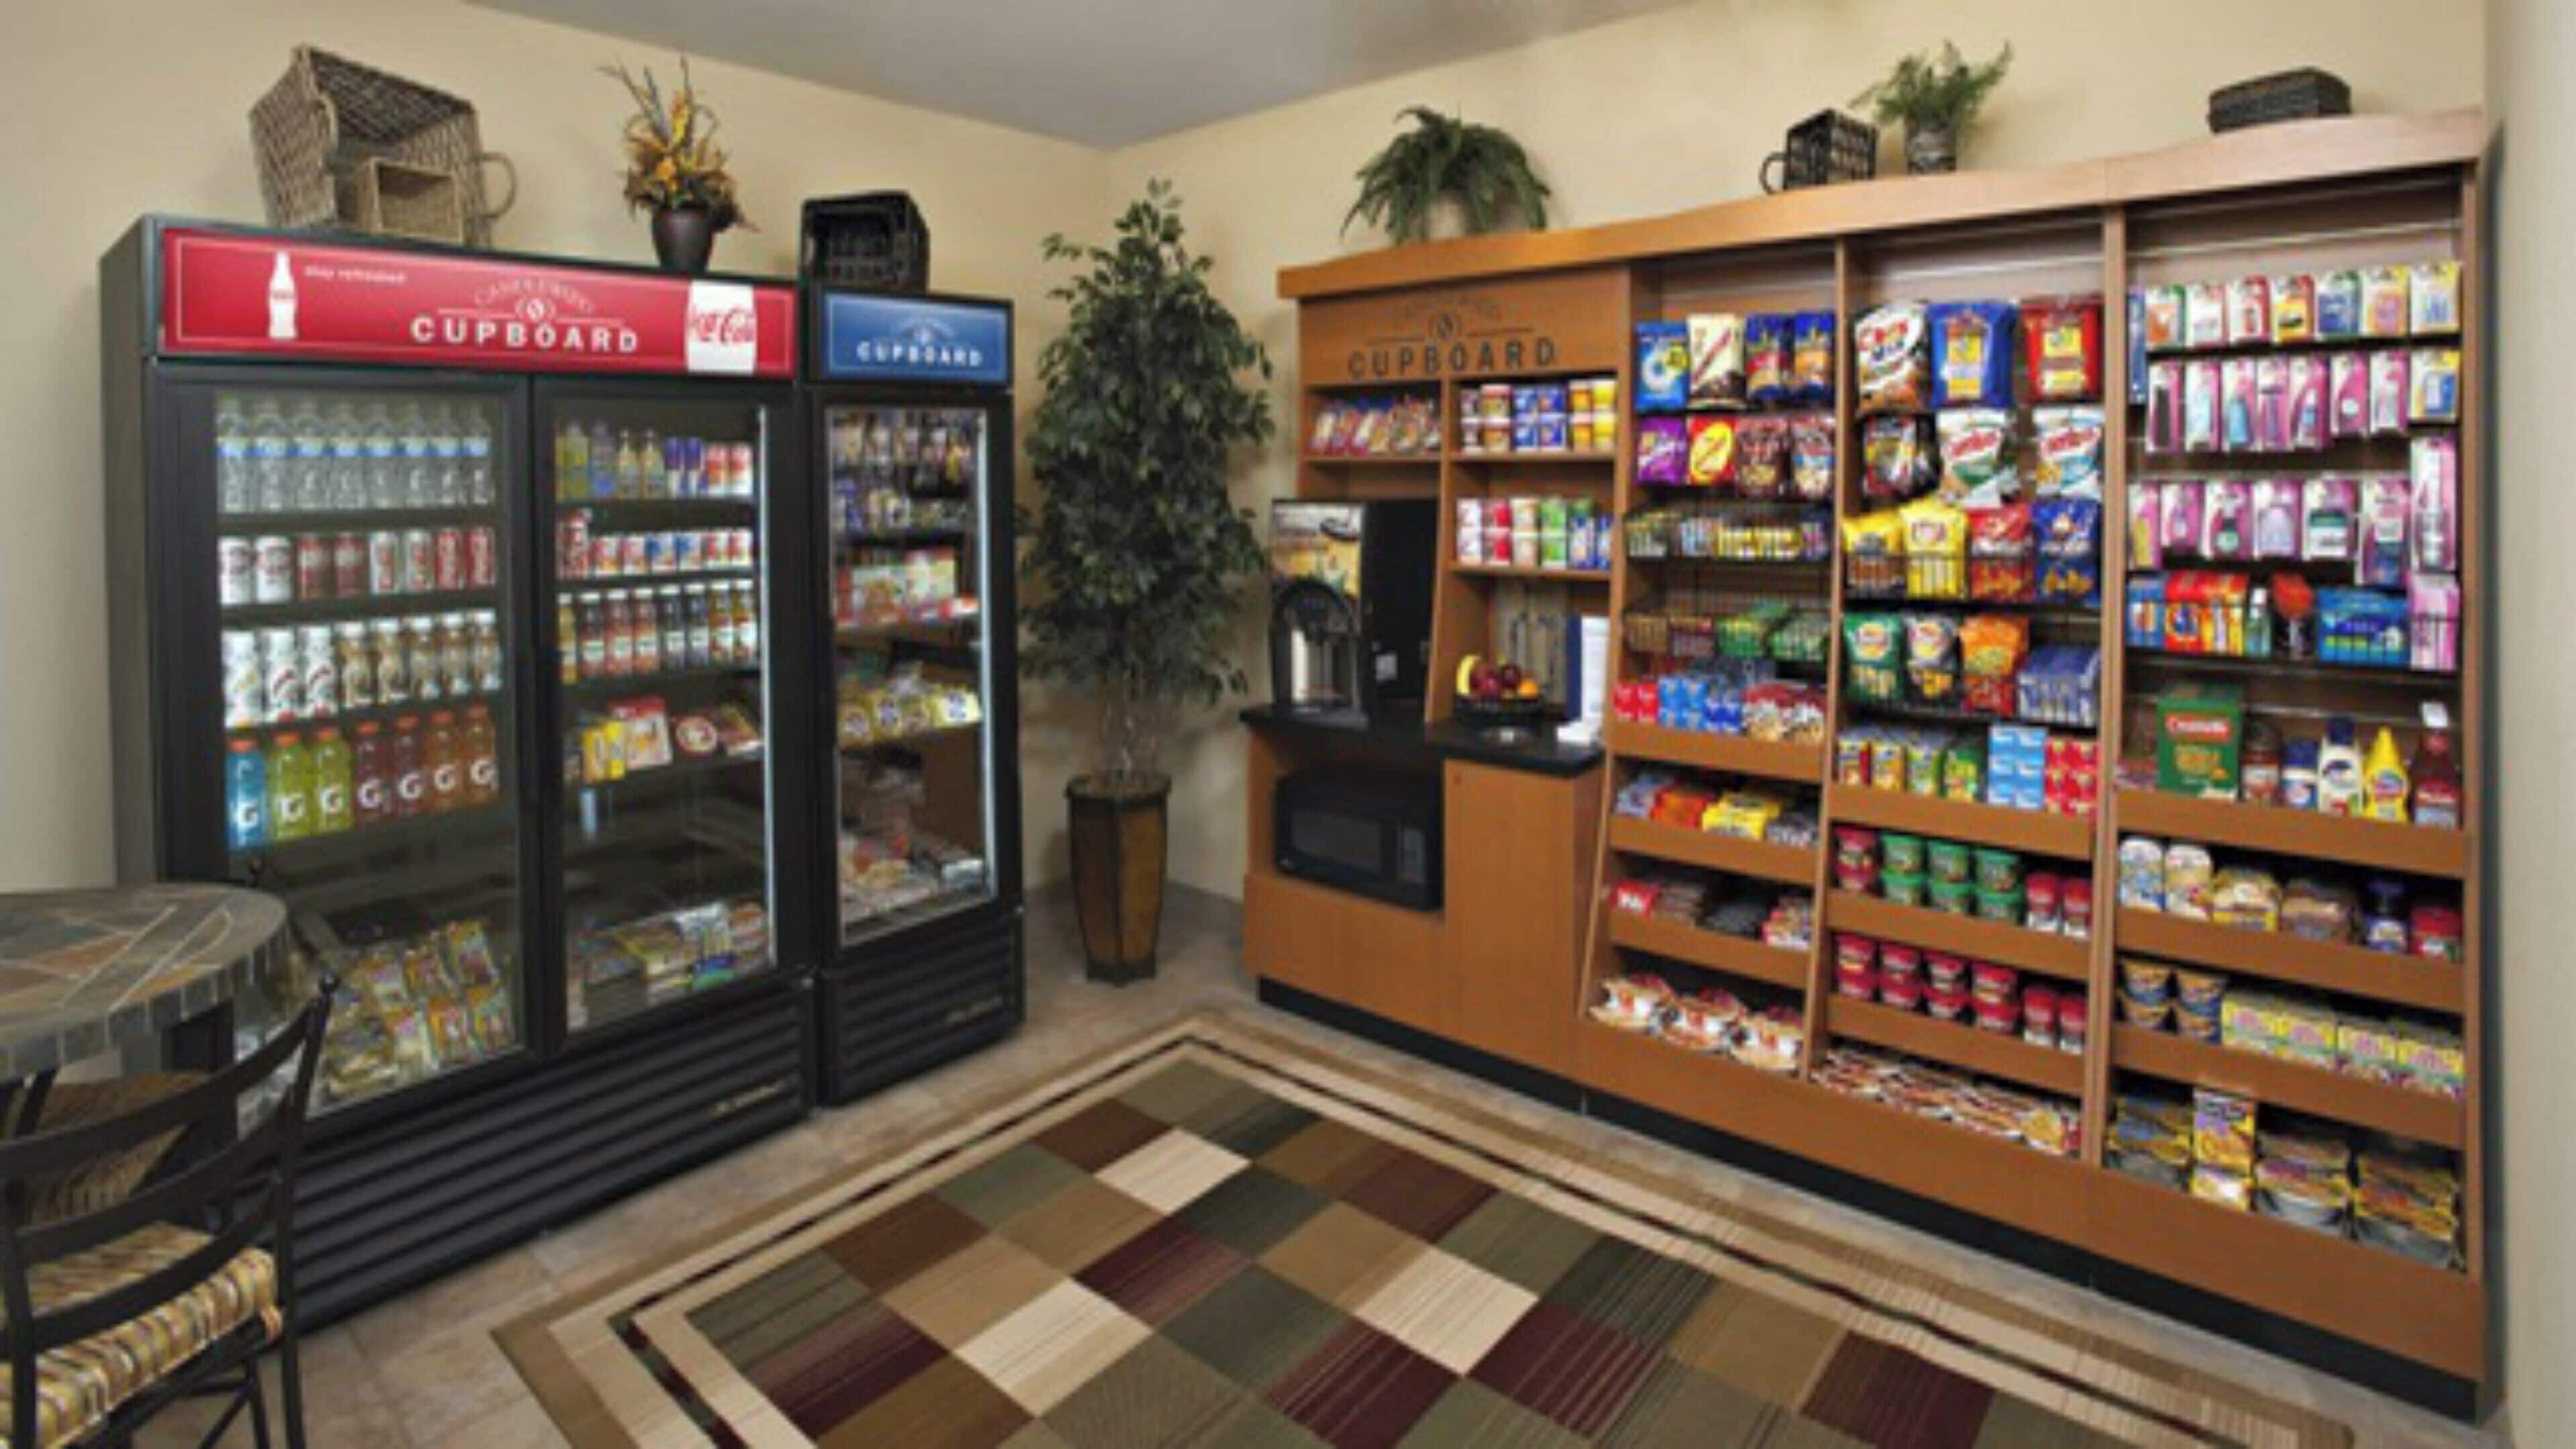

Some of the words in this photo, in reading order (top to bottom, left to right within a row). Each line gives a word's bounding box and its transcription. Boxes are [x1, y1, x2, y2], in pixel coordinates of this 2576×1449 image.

[411, 314, 637, 353] CUPBOARD
[857, 341, 983, 367] CUPBOARD
[1348, 337, 1554, 378] CUPBOARD
[471, 759, 495, 786] G
[358, 778, 381, 809] G
[398, 773, 423, 801] G
[236, 800, 260, 828] G
